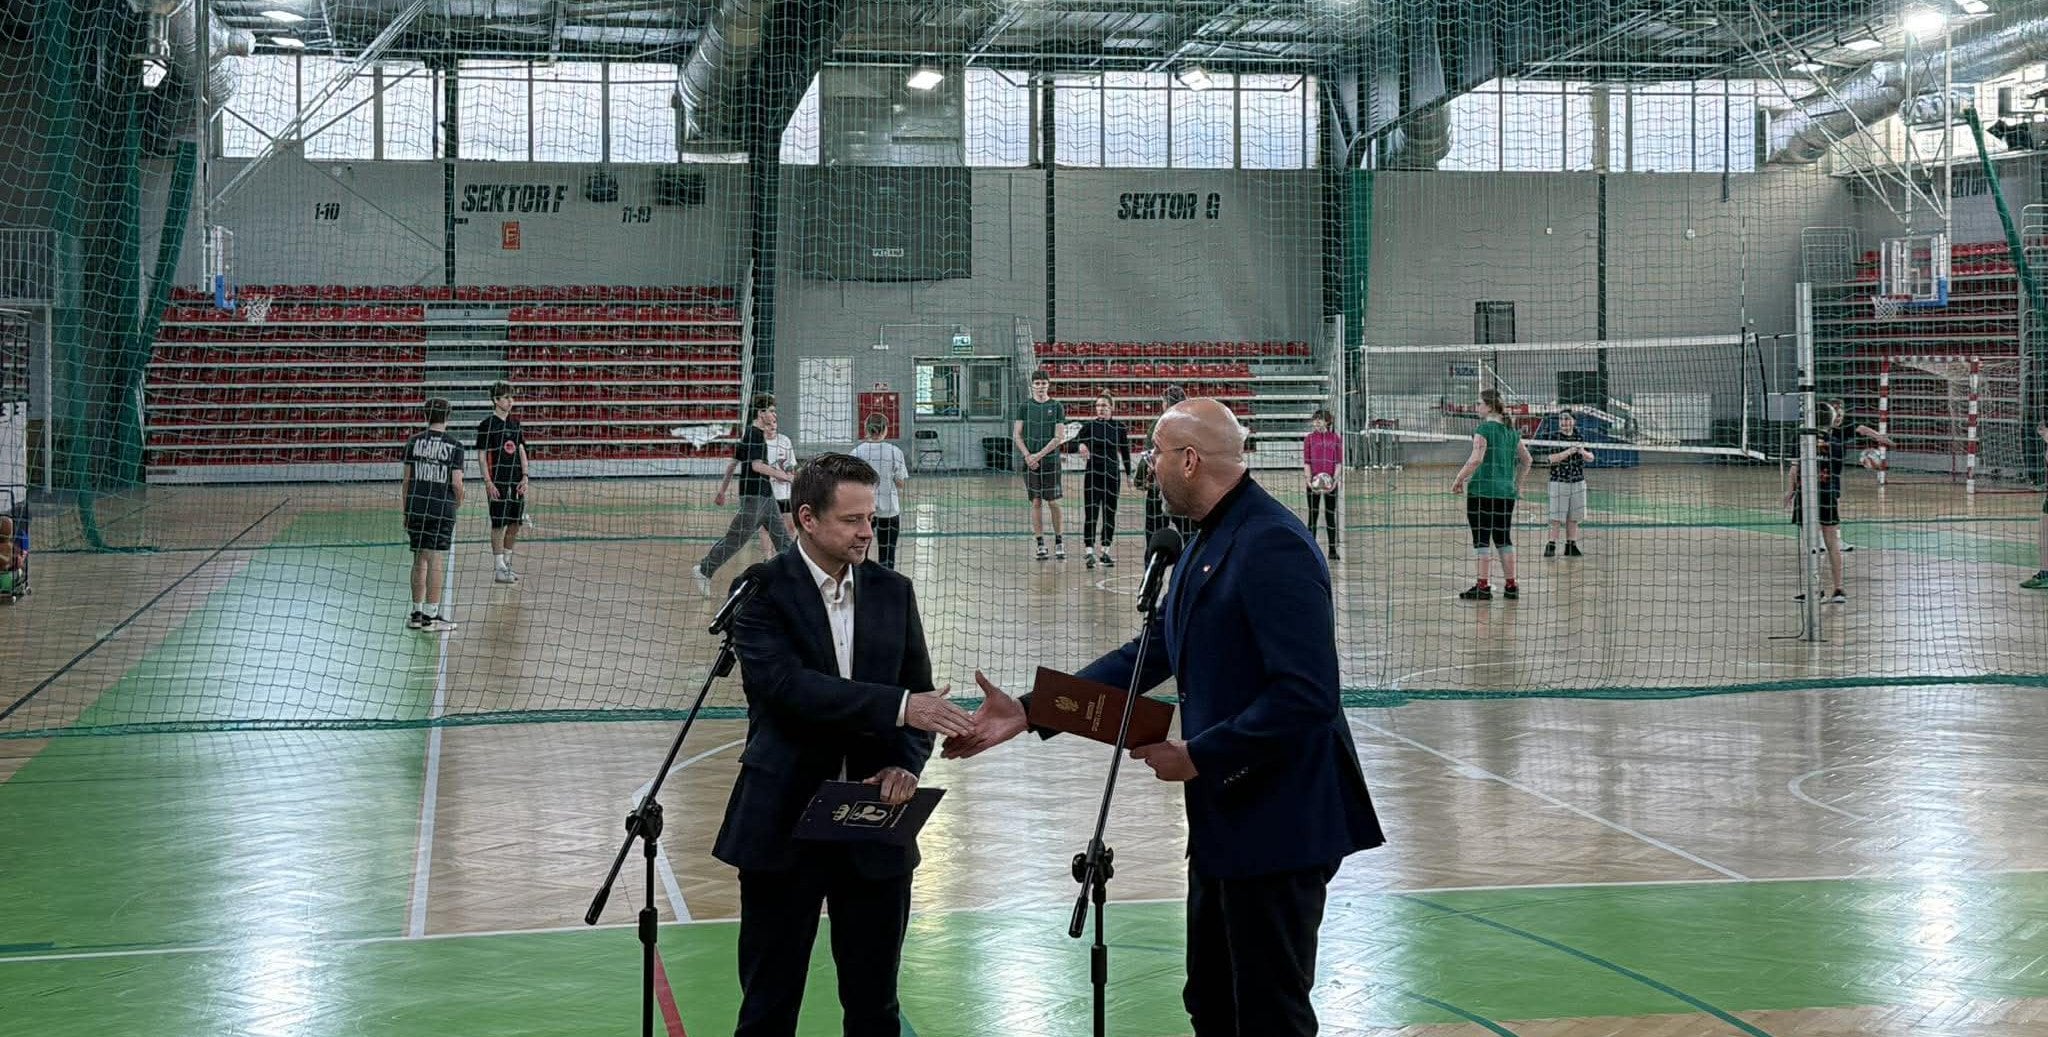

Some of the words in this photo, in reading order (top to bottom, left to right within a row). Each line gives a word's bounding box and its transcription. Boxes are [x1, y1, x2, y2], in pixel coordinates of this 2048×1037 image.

[462, 184, 550, 213] SEKTOR
[552, 185, 569, 213] F
[1117, 193, 1198, 220] SEKTOR
[1206, 193, 1221, 220] G
[315, 202, 340, 220] 1-10
[413, 439, 456, 461] AGAINST
[415, 461, 448, 484] WORLD
